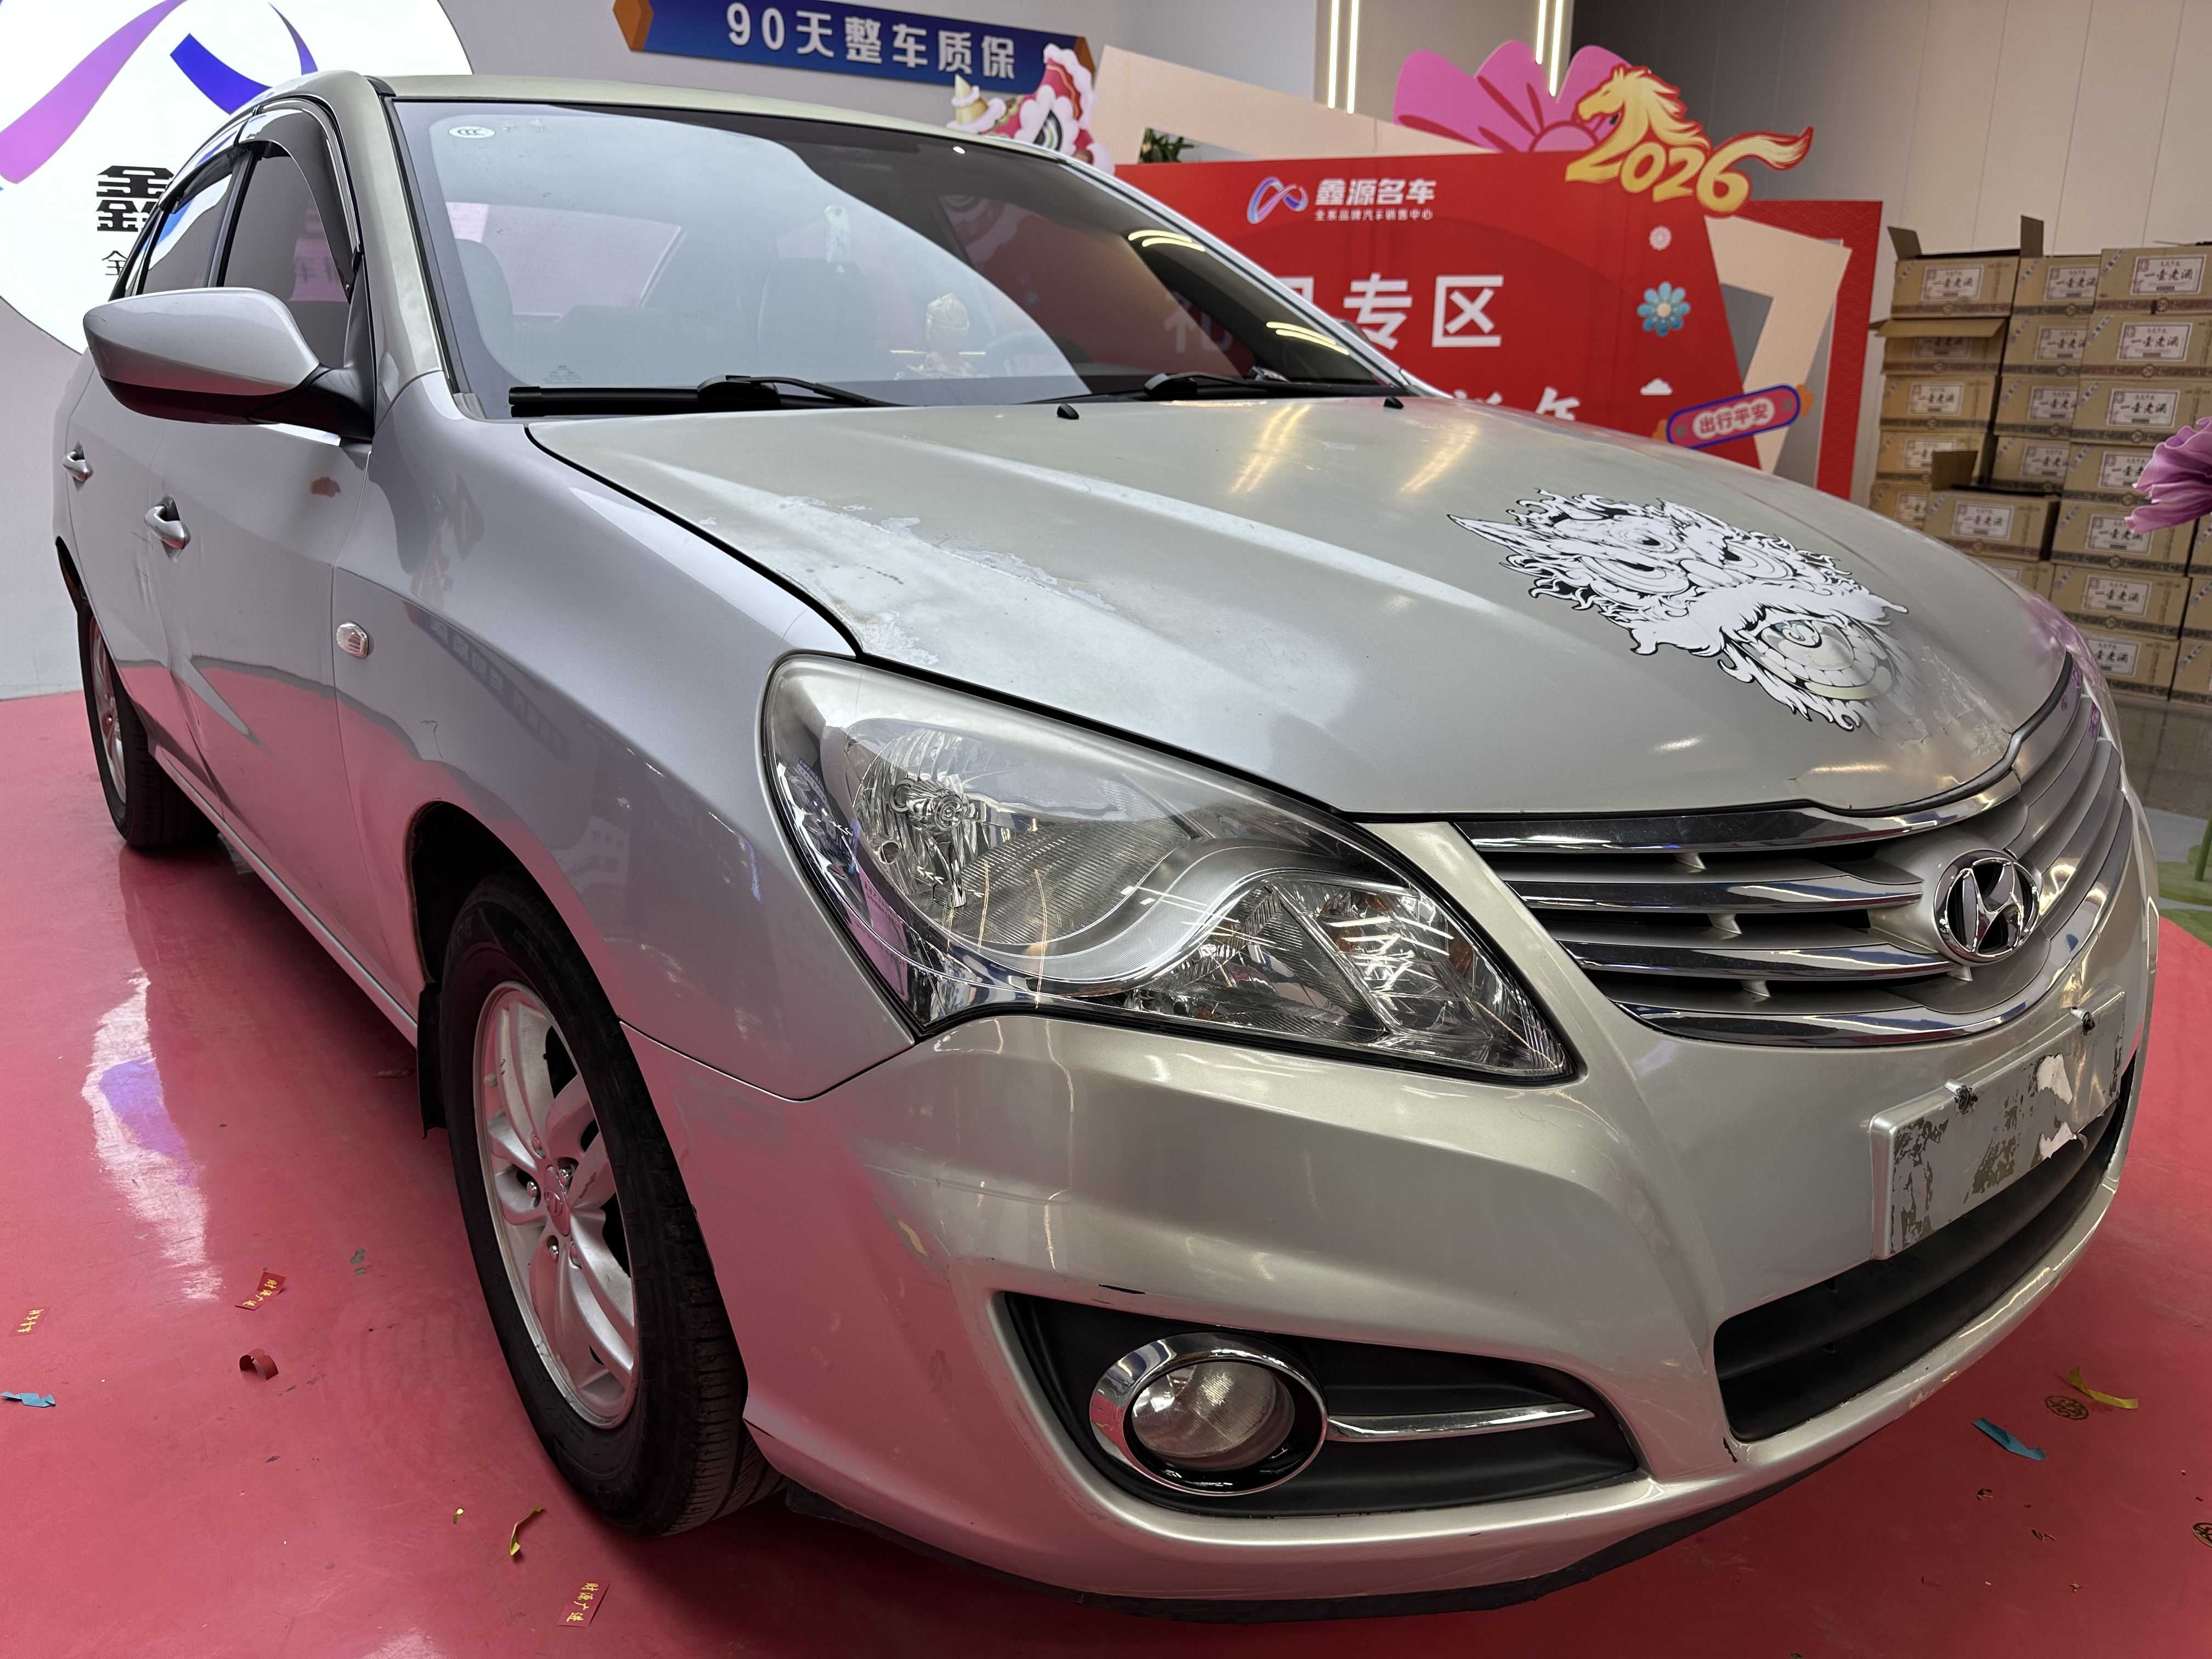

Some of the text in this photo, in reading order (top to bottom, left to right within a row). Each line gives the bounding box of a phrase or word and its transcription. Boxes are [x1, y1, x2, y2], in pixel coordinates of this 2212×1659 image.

[726, 2, 1016, 81] 90天整车质保
[1314, 178, 1437, 206] 鑫源名车
[1699, 403, 1769, 433] 出行平安
[566, 1582, 599, 1622] 财源广进
